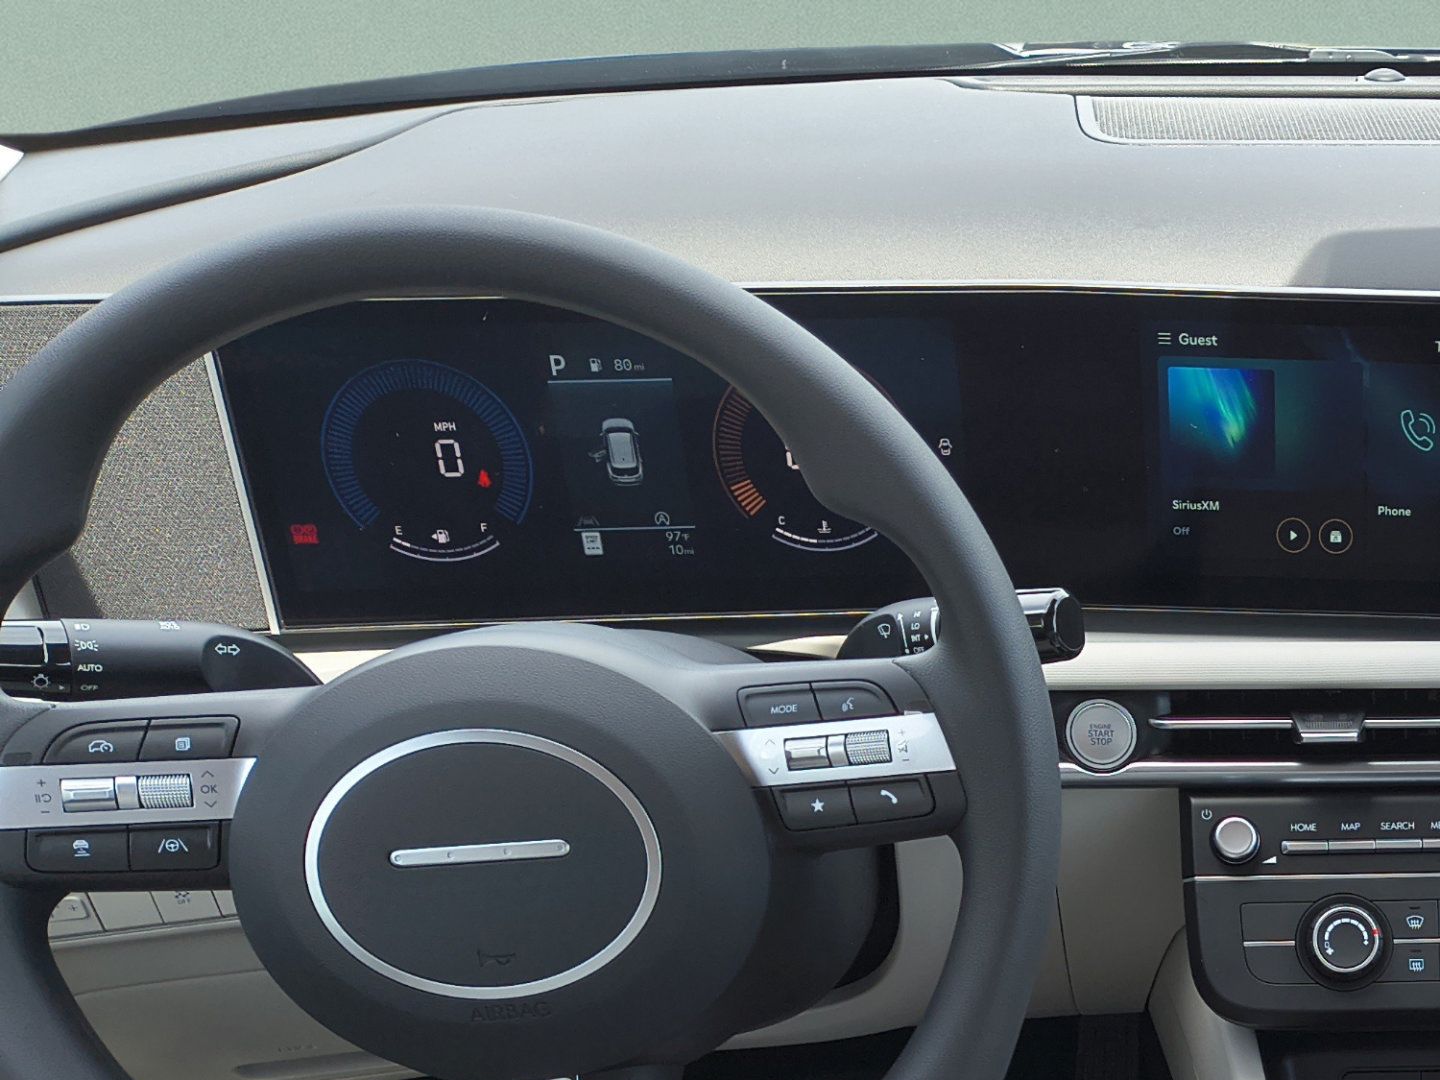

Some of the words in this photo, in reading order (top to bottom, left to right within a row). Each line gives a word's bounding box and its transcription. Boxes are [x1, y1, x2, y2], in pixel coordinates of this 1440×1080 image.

[1178, 333, 1218, 347] Guest
[549, 354, 566, 376] P
[433, 421, 457, 432] MPH
[434, 439, 465, 478] 0
[1172, 500, 1220, 511] SiriusXM
[1377, 506, 1412, 517] Phone
[394, 525, 403, 536] E
[480, 523, 488, 533] F
[1172, 526, 1191, 537] Off
[77, 664, 103, 672] AUTO
[770, 702, 798, 715] MODE
[200, 783, 218, 795] OK
[1290, 823, 1317, 832] HOME
[1341, 822, 1361, 831] MAP
[1380, 822, 1415, 831] SEARCH
[469, 1002, 554, 1023] AIRBAG
